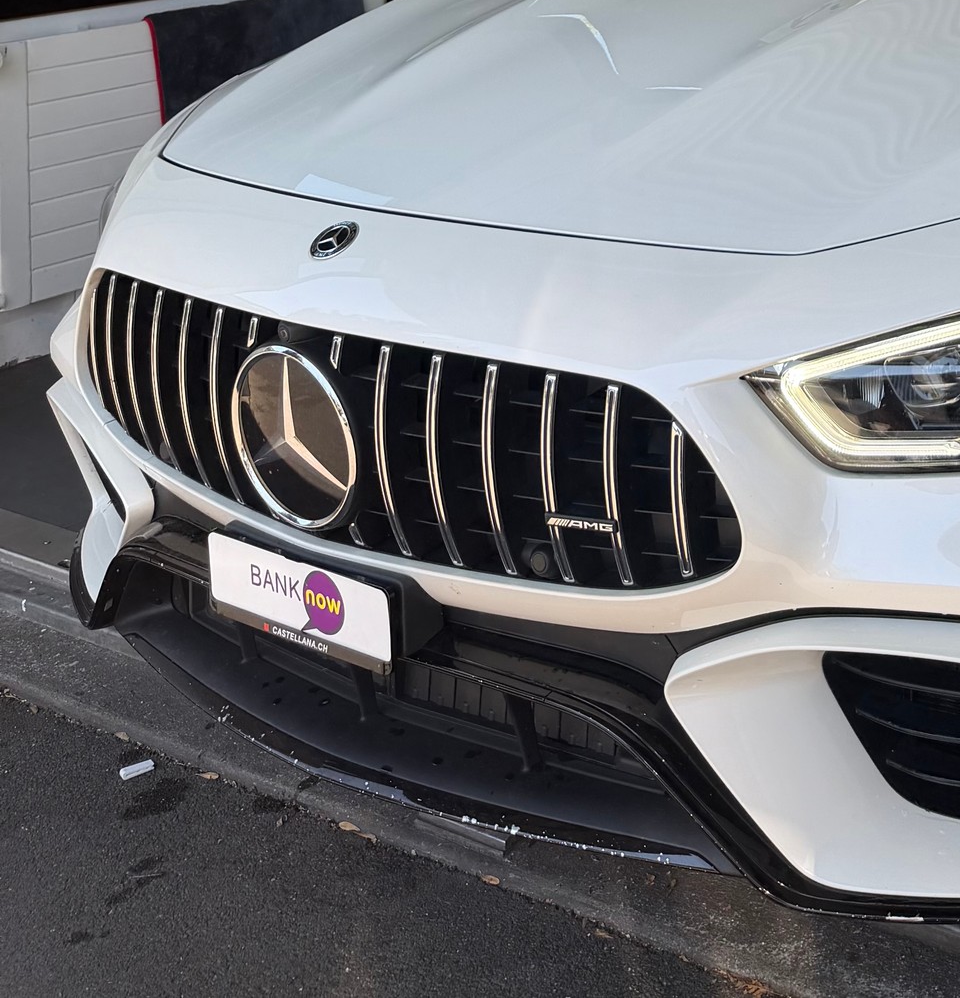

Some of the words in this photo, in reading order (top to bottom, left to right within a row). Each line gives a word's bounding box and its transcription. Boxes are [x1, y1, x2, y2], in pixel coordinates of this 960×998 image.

[567, 519, 613, 532] AMG
[250, 563, 301, 602] BANK
[305, 588, 341, 615] now
[272, 626, 329, 654] CASTELLANA.CH
